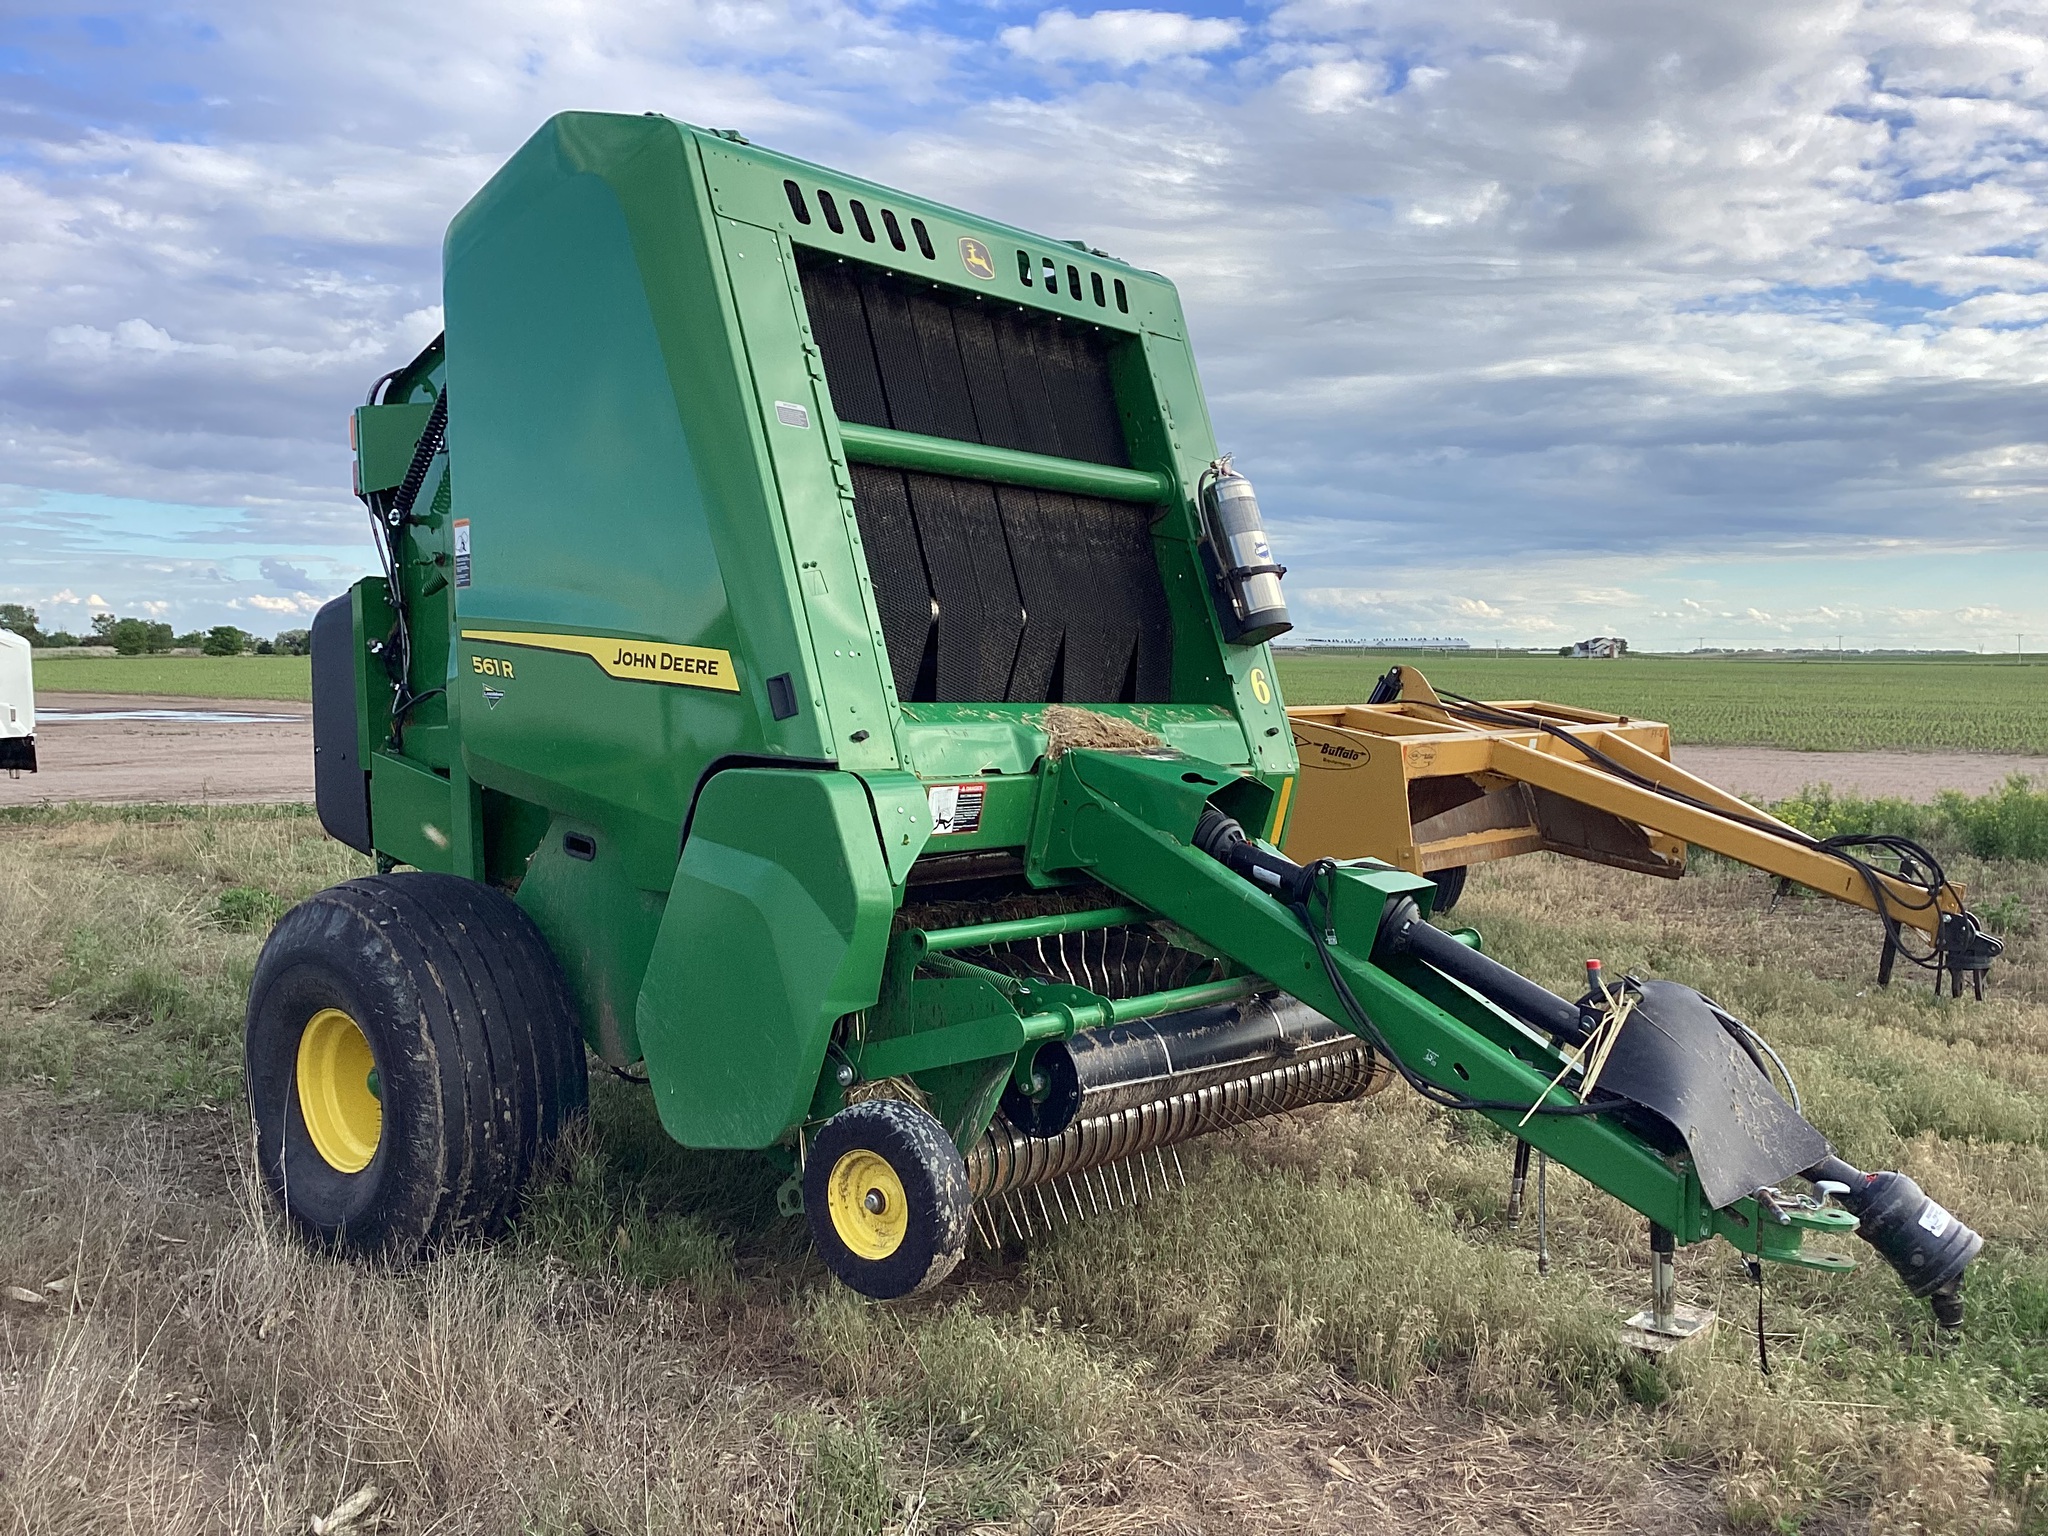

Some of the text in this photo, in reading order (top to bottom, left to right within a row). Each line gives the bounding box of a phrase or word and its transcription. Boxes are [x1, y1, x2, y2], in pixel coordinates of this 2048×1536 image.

[471, 655, 516, 679] 561 R
[613, 648, 719, 676] JOHN DEERE
[1250, 668, 1271, 705] 6
[1320, 743, 1359, 761] Buffalo
